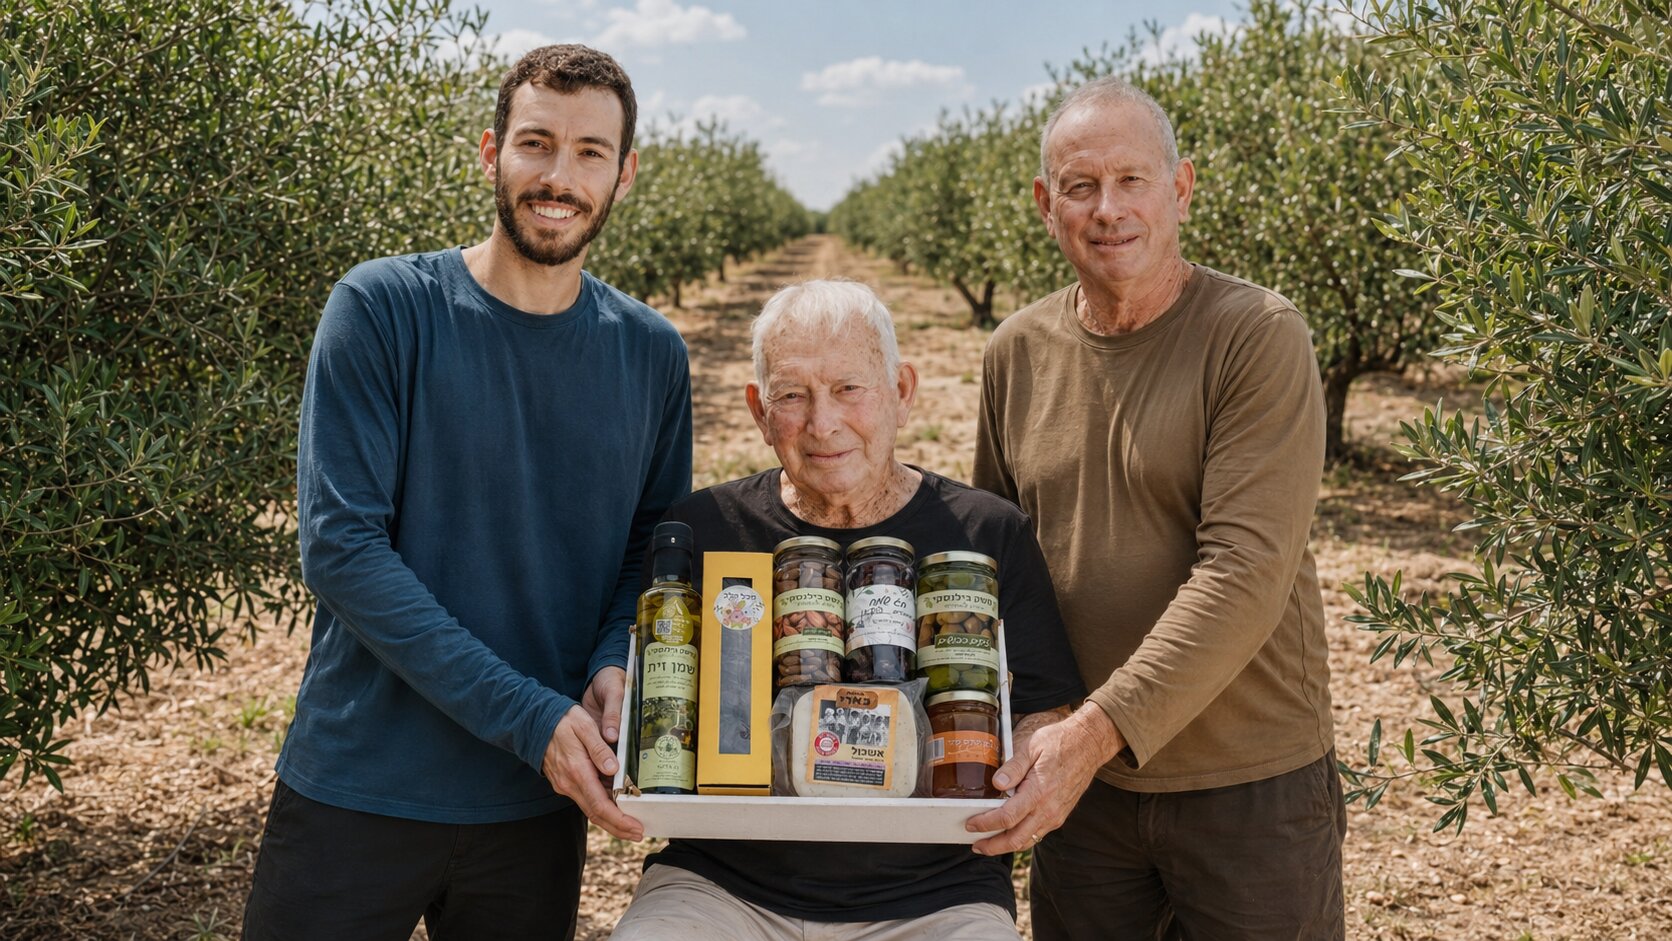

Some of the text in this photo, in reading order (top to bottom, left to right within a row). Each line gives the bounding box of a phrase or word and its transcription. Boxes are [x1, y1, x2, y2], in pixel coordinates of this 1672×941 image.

[647, 661, 695, 675] שמן זית
[851, 746, 885, 758] אשכול
